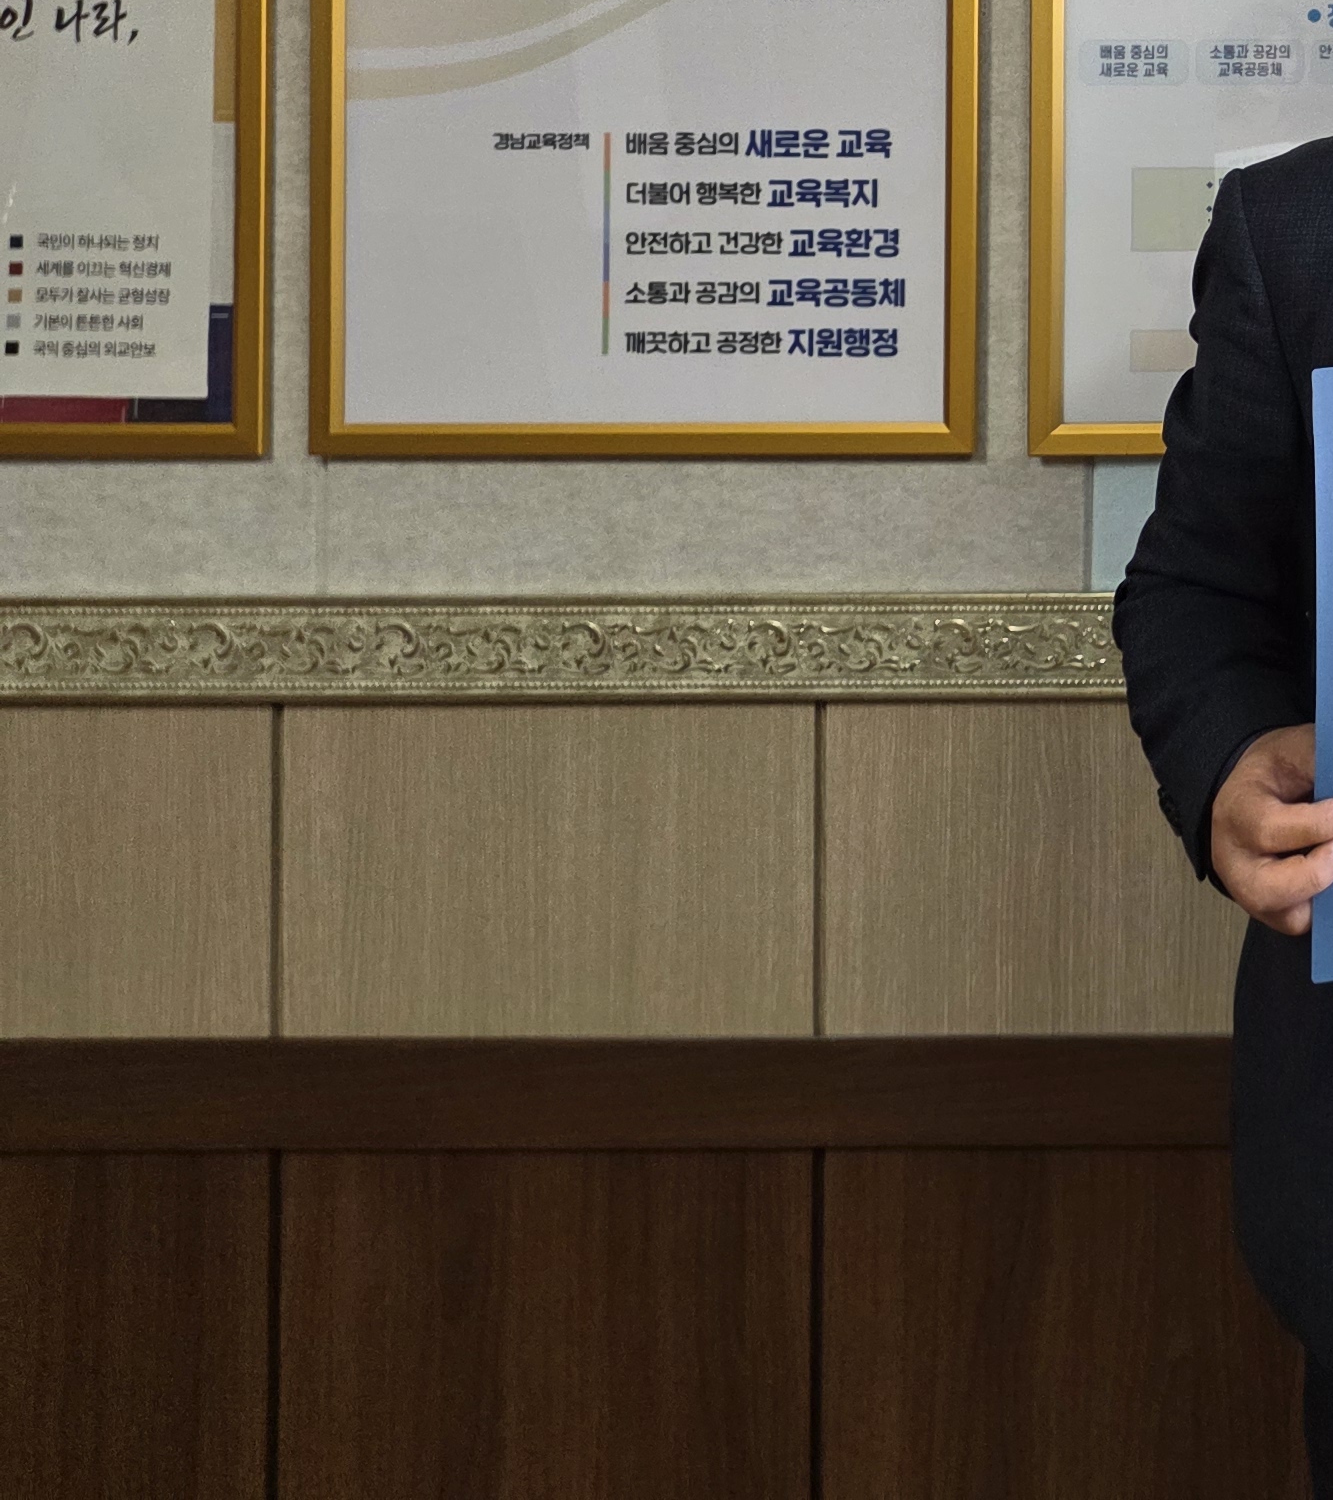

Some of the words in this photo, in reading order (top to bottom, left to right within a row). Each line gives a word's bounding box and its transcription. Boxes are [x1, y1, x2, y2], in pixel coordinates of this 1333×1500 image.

[493, 133, 589, 150] 경남교육정책
[626, 132, 669, 155] 배움
[674, 132, 739, 156] 중심의
[745, 129, 830, 158] 새로운
[836, 129, 892, 158] 교육
[626, 182, 690, 205] 더불어
[696, 182, 762, 205] 행복한
[767, 179, 878, 208] 교육복지
[626, 232, 712, 255] 안전하고
[718, 232, 783, 255] 건강한
[788, 229, 899, 258] 교육환경
[625, 282, 691, 304] 소통과
[695, 282, 760, 304] 공감의
[767, 278, 905, 307] 교육공동체
[625, 331, 711, 354] 깨끗하고
[717, 331, 782, 354] 공정한
[788, 328, 898, 357] 지원행정
